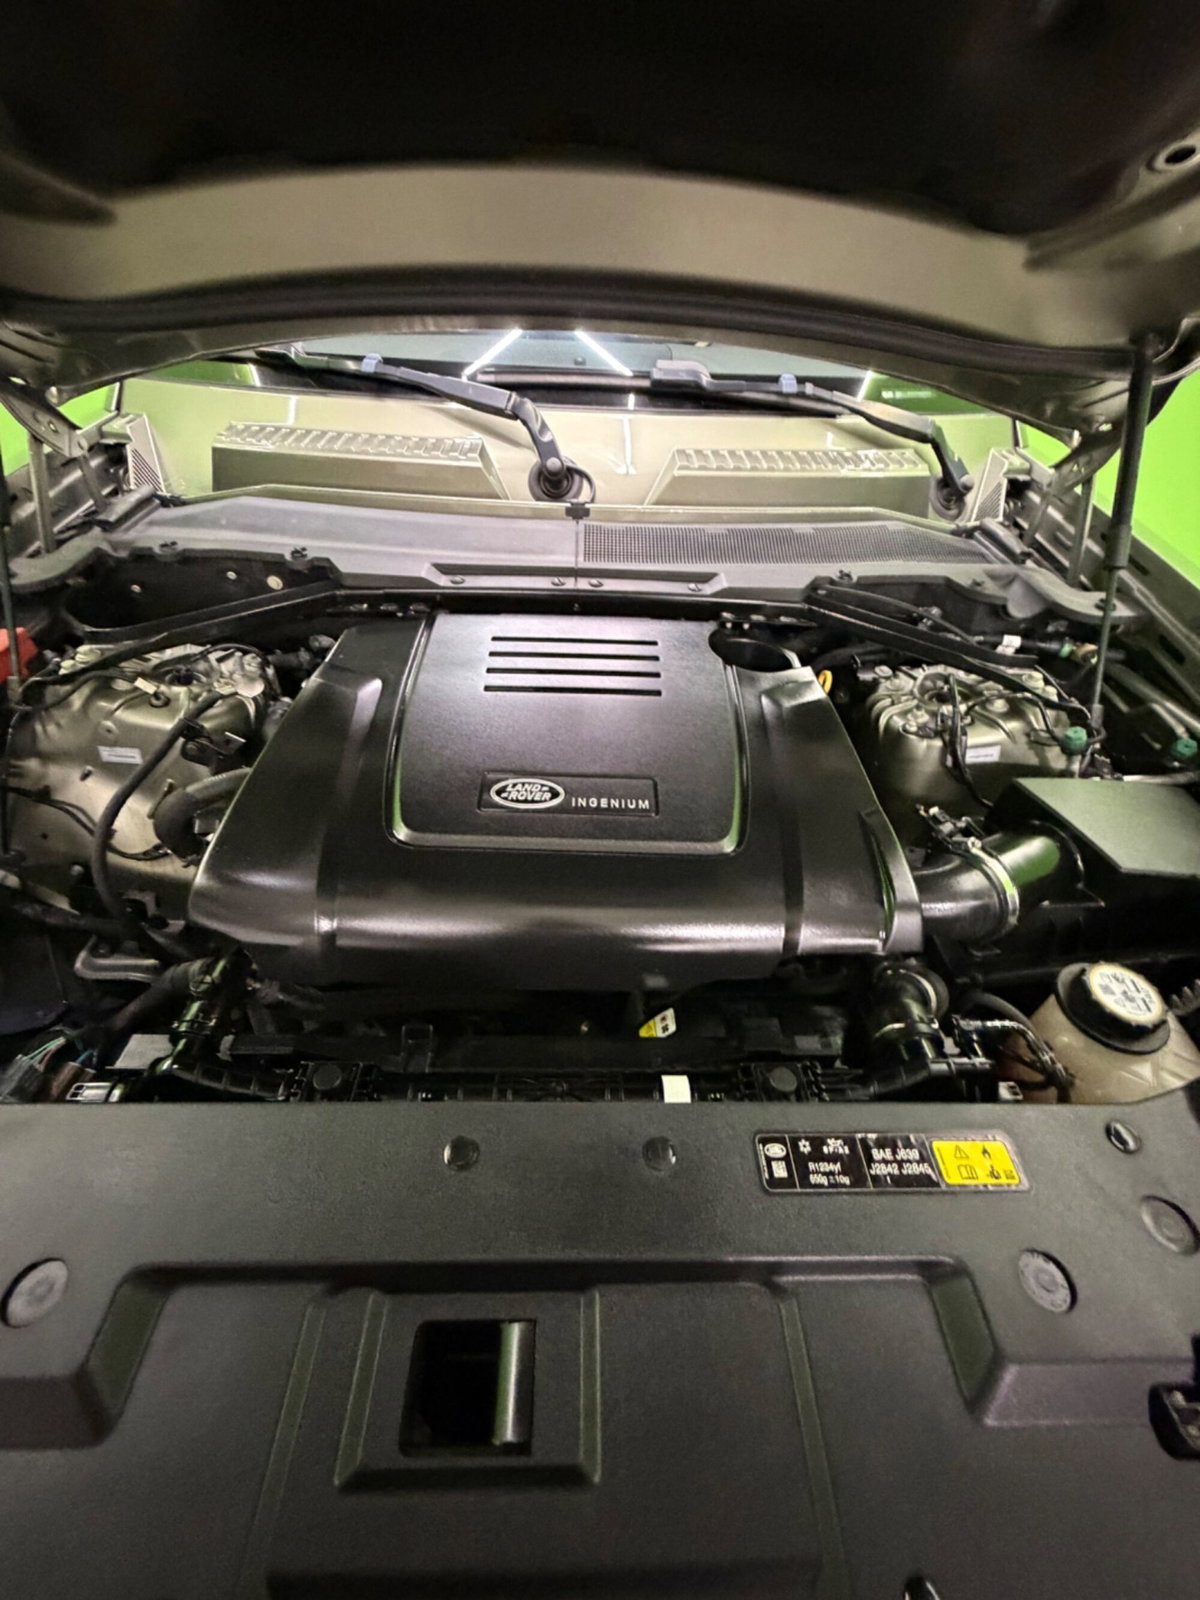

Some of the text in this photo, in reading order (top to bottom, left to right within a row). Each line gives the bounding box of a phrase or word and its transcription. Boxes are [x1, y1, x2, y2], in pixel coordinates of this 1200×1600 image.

[507, 783, 541, 792] LAND
[509, 791, 552, 801] ROVER
[572, 797, 650, 809] INGENIUM
[870, 1162, 900, 1175] J2842
